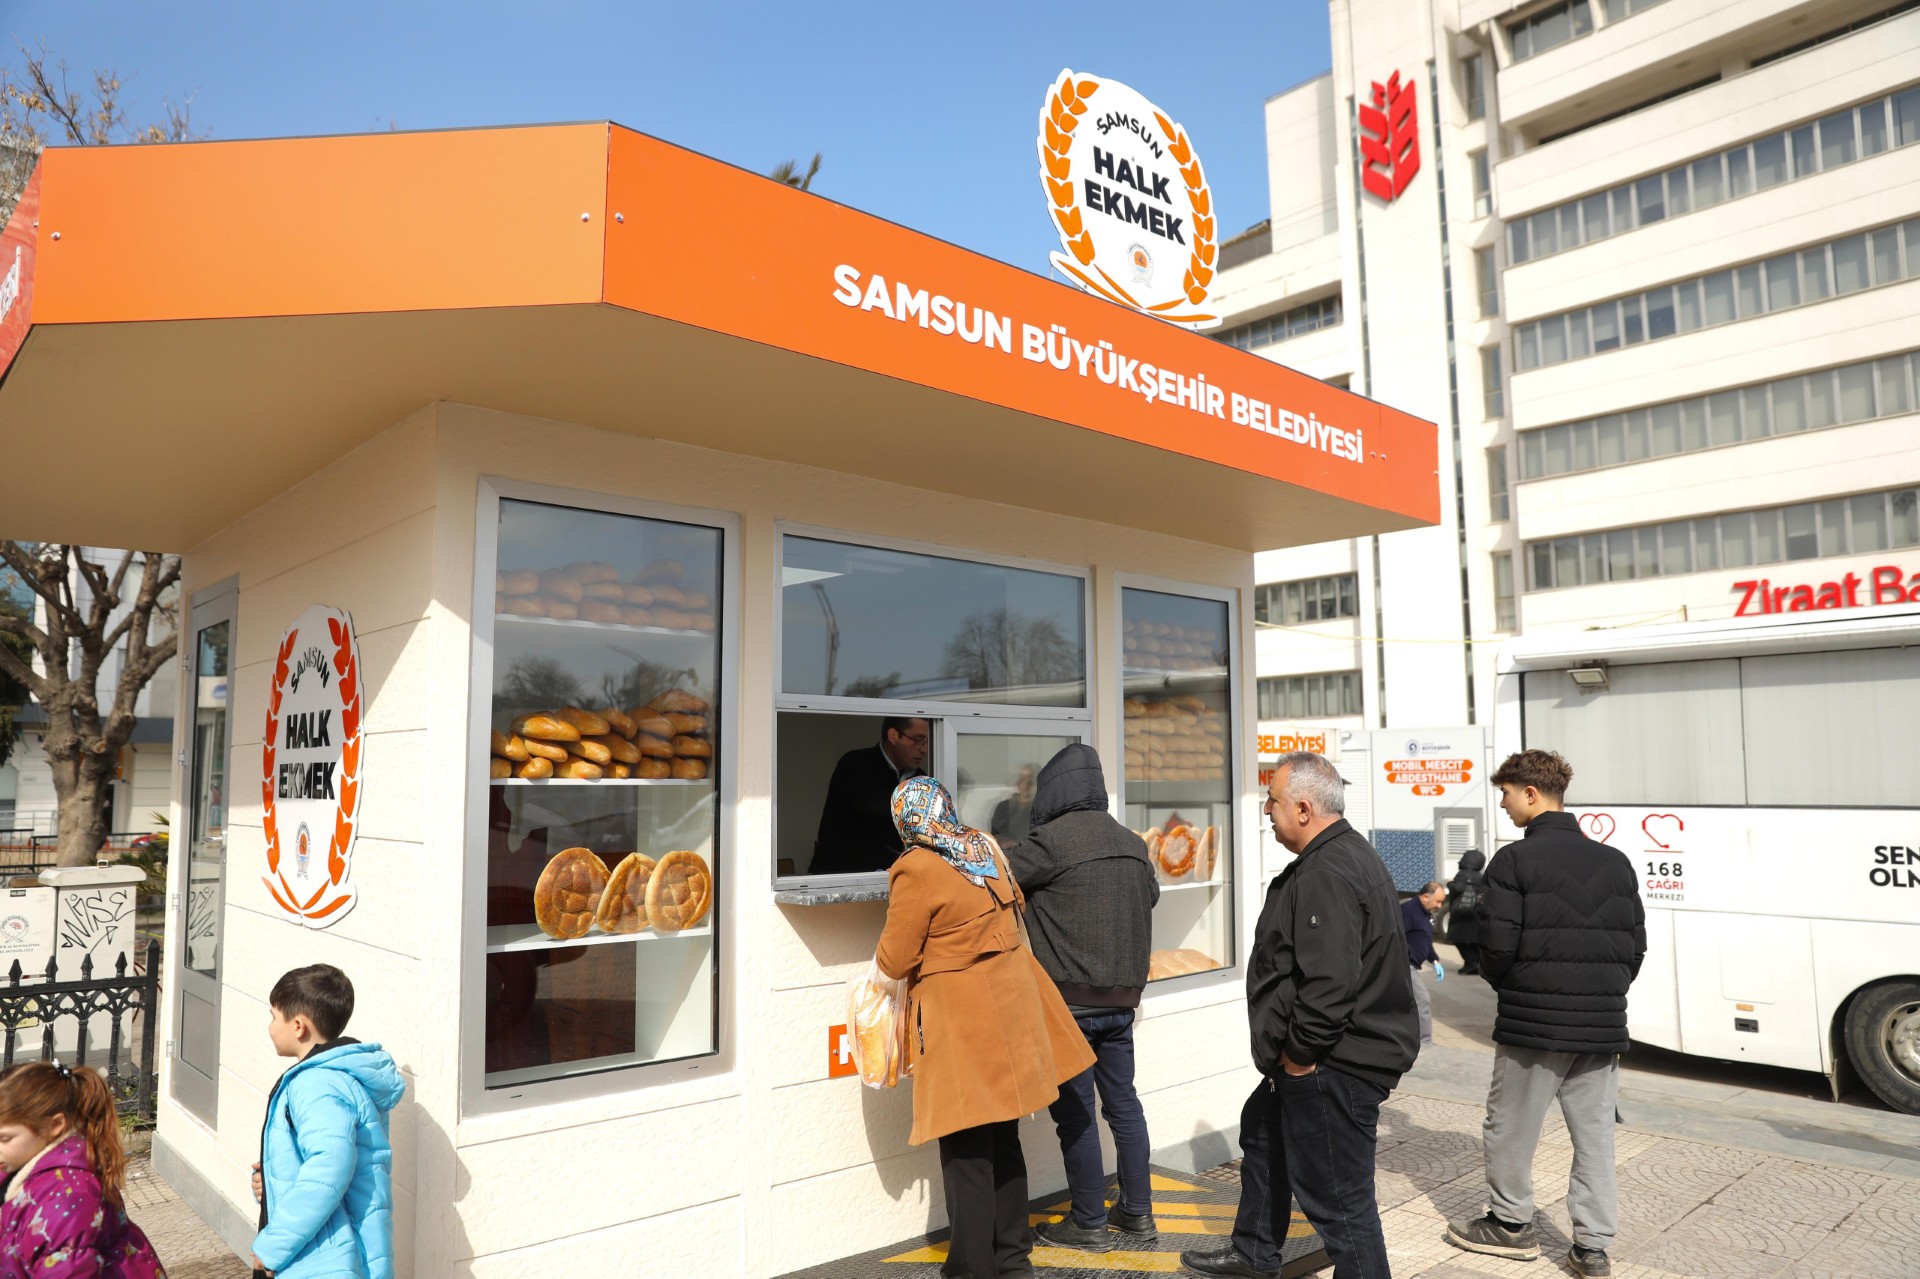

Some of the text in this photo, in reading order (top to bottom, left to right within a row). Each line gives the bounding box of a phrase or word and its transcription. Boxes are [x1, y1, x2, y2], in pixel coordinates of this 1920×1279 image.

[1096, 111, 1163, 159] SAMSUN
[1093, 145, 1173, 205] HALK
[1084, 178, 1186, 246] EKMEK
[832, 263, 1363, 464] SAMSUN BÜYÜKŞEHİR BELEDİYESİ
[1732, 572, 1864, 617] Ziraat
[291, 646, 330, 694] SAMSUN
[286, 709, 331, 749] HALK
[279, 761, 336, 800] EKMEK
[1395, 772, 1462, 783] ABDESTHANE
[1419, 785, 1438, 795] WC
[1647, 862, 1683, 877] 168
[1647, 879, 1684, 891] ÇAĞRI
[1647, 892, 1685, 901] MERKEZİ
